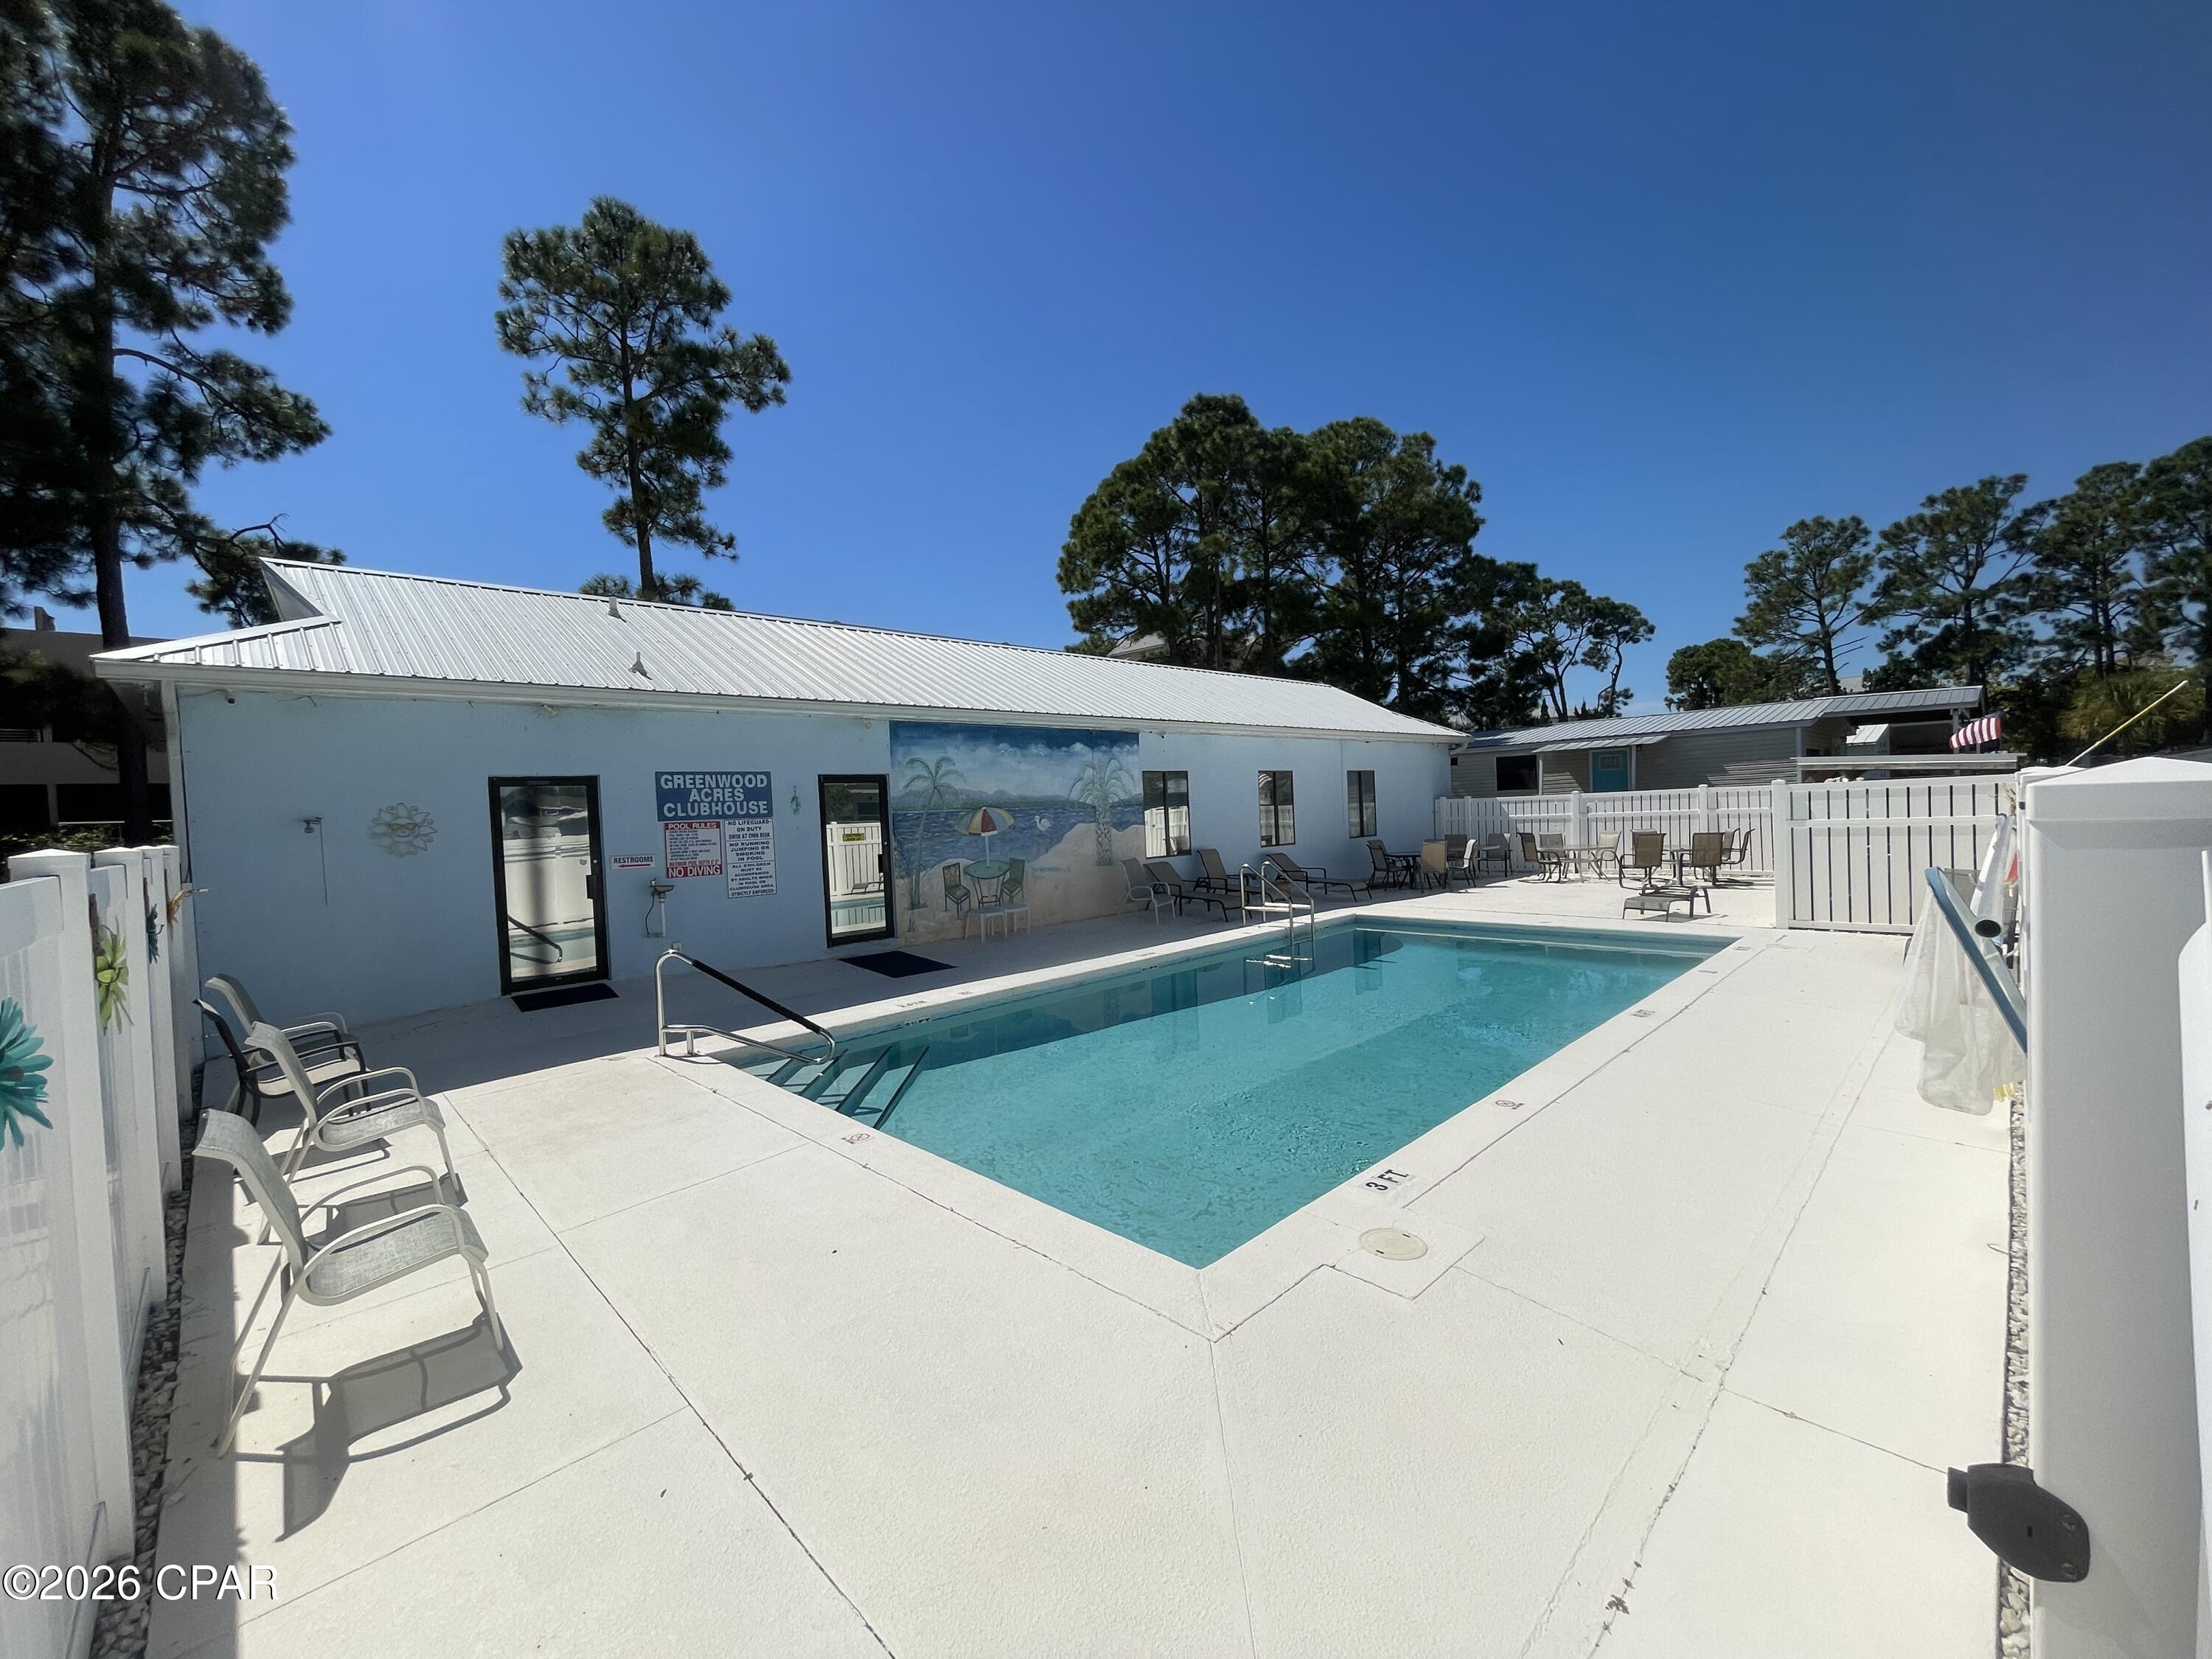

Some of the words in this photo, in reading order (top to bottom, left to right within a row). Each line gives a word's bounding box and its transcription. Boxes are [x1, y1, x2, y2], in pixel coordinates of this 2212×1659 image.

[661, 774, 768, 789] GREENWOOD
[689, 787, 744, 801] ACRES
[664, 801, 768, 817] CLUBHOUSE
[668, 867, 684, 877] NO
[687, 865, 720, 876] DIVING
[1366, 1181, 1388, 1191] 3
